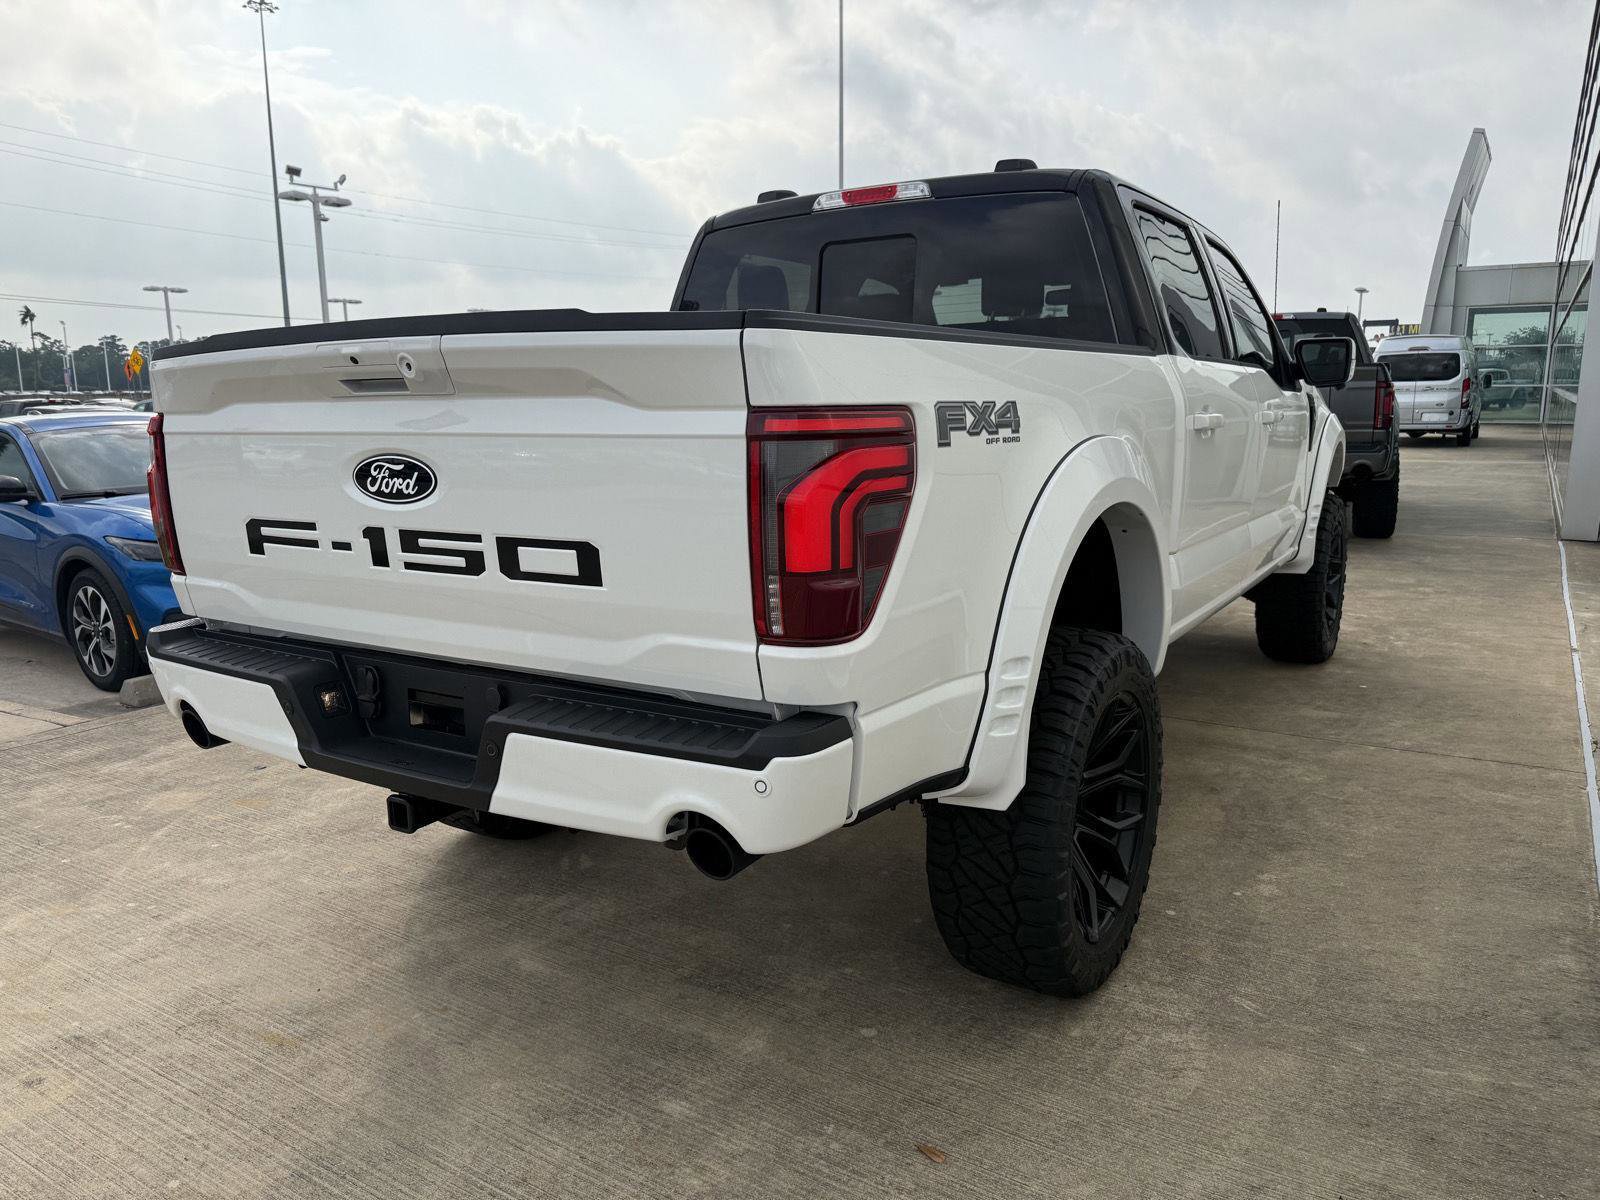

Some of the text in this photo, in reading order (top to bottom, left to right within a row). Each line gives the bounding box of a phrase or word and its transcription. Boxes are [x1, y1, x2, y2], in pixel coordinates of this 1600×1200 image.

[934, 400, 1021, 448] FX4
[985, 436, 1021, 445] OFF ROAD
[366, 461, 419, 495] Ford
[245, 517, 604, 588] F-150
